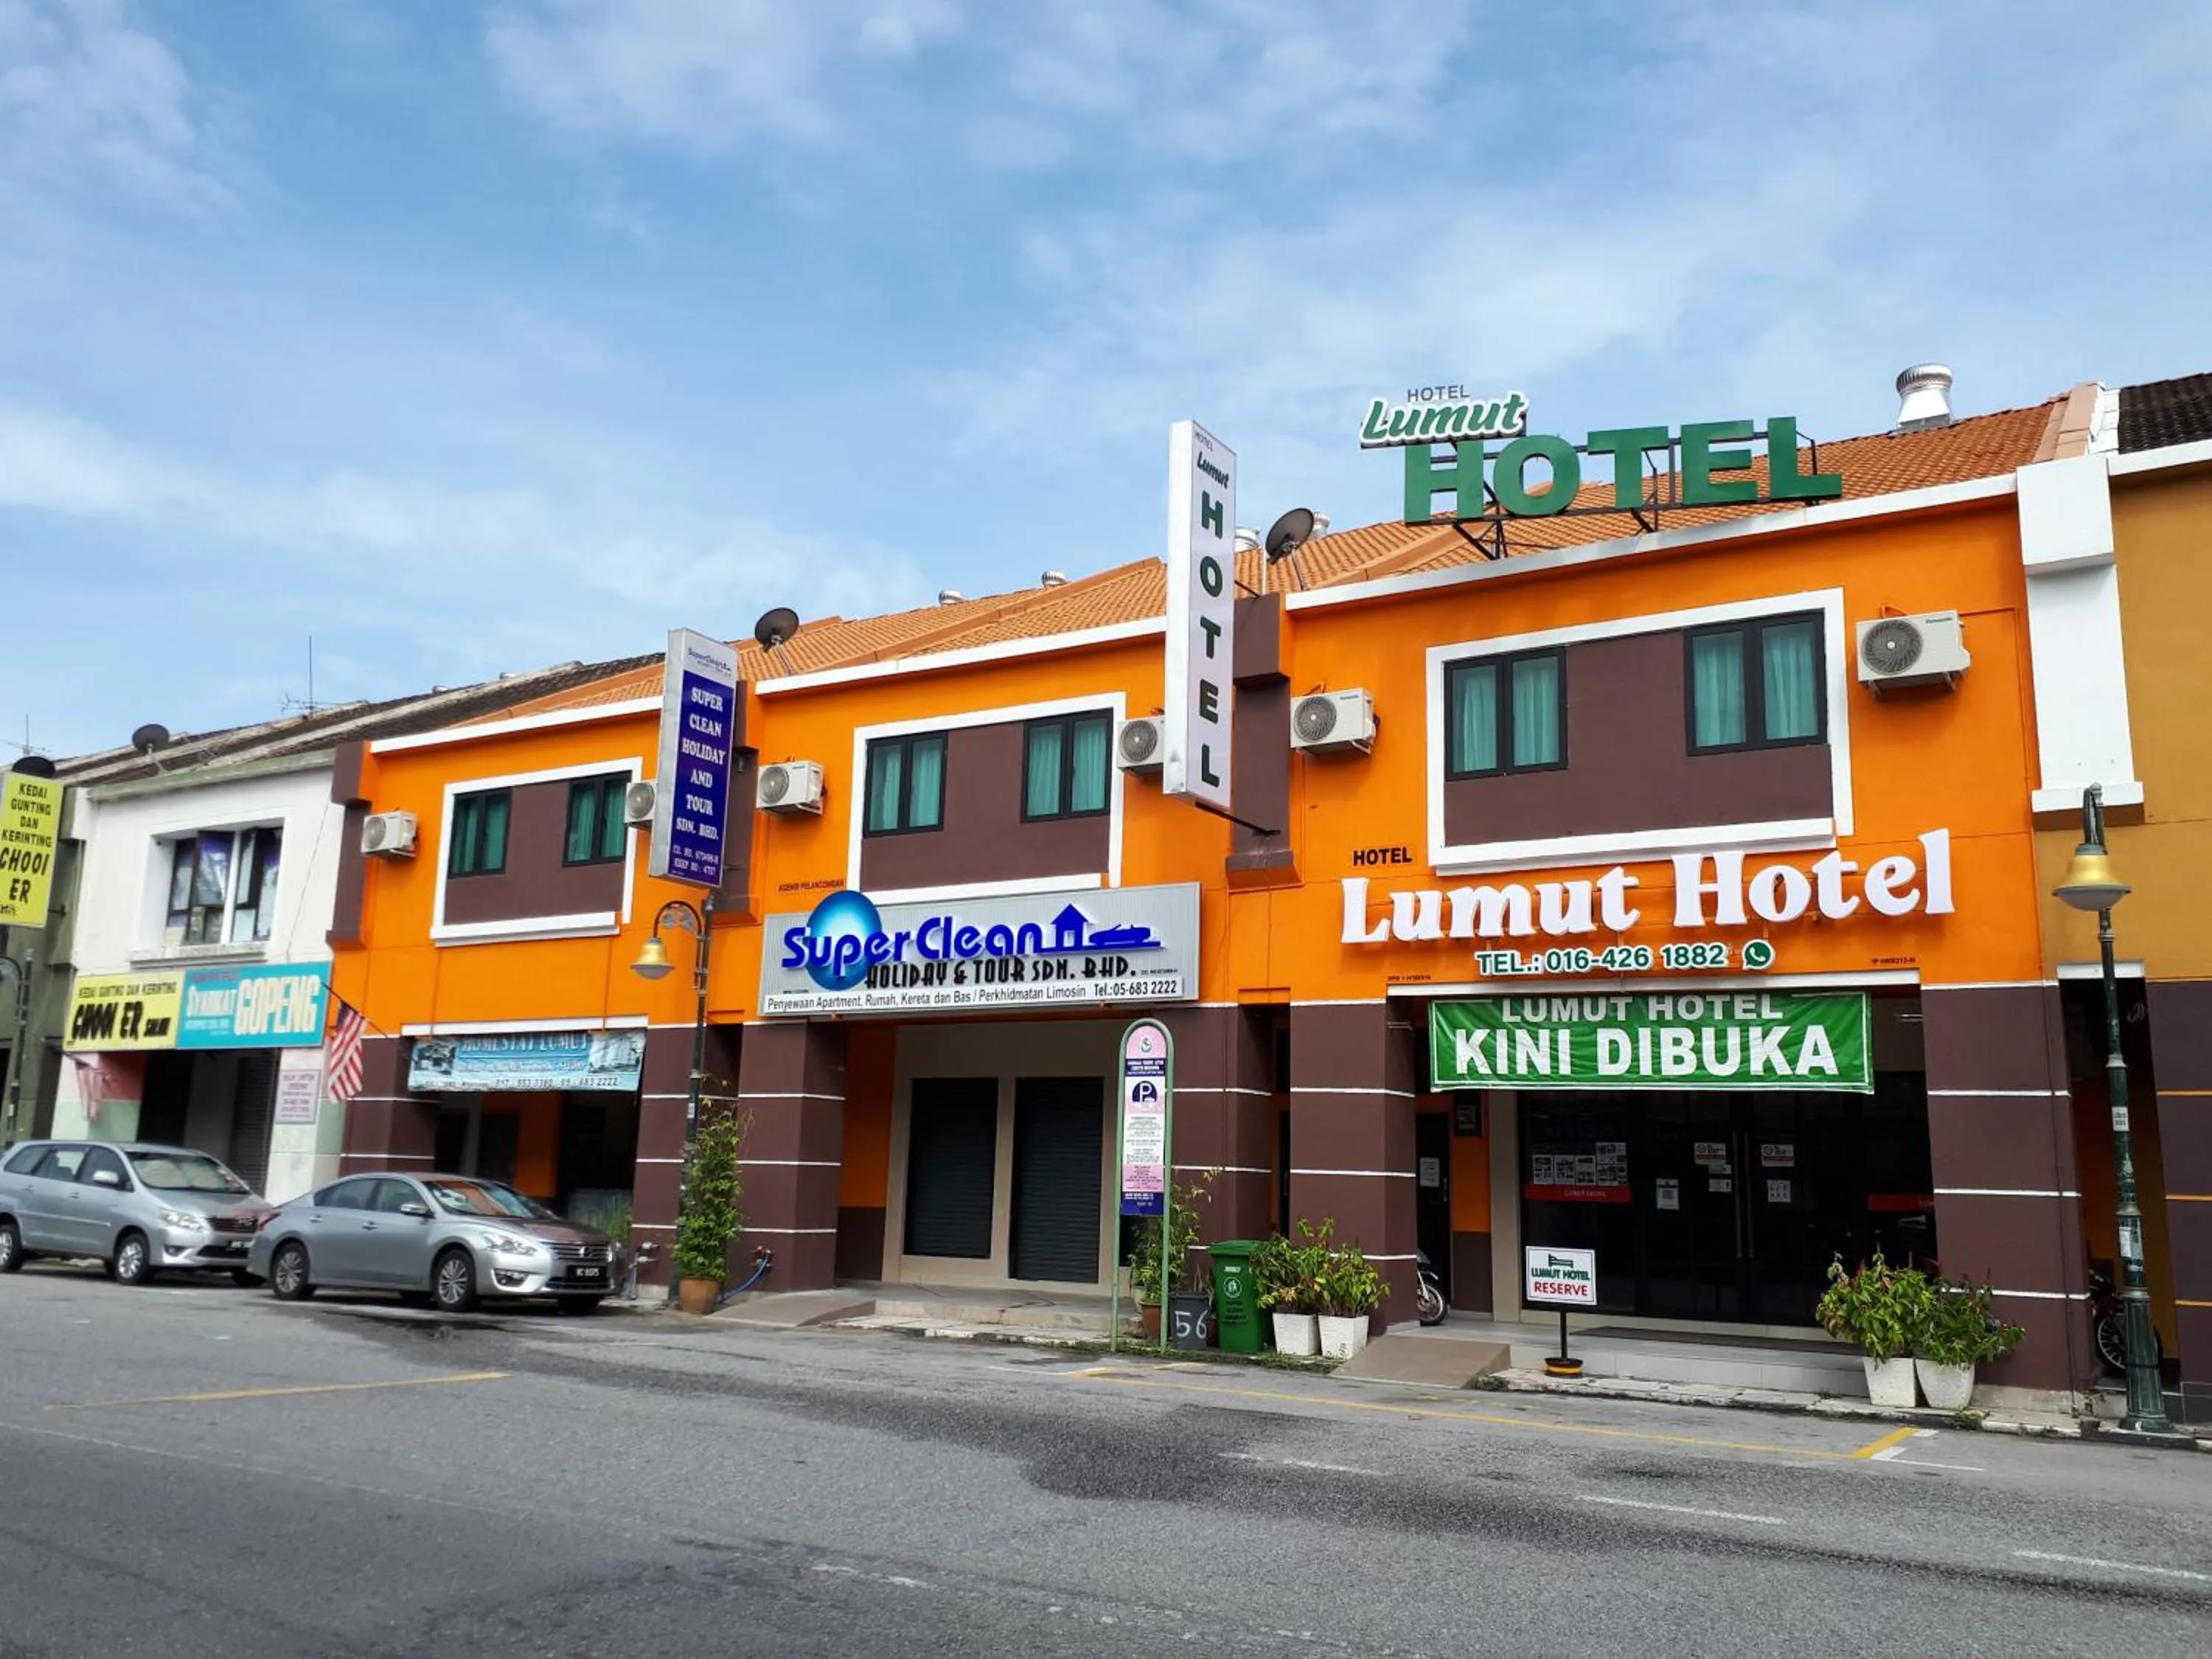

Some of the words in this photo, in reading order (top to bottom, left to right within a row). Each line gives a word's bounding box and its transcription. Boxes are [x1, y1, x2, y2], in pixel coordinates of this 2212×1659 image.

[1408, 384, 1470, 403] HOTEL
[1362, 392, 1525, 440] Lumut
[1197, 451, 1230, 490] Lumut
[1404, 416, 1843, 523] HOTEL
[1199, 490, 1223, 788] HOTEL
[691, 686, 723, 712] SUPER
[689, 713, 723, 737] CLEAN
[682, 738, 726, 765] HOLIDAY
[18, 782, 48, 799] KEDAI
[690, 768, 713, 788] AND
[11, 798, 52, 815] GUNTING
[685, 794, 713, 816] TOUR
[20, 815, 39, 830] DAN
[676, 817, 697, 834] SDN.
[1, 828, 52, 848] KERINTING
[0, 846, 49, 876] CHOOI
[1353, 847, 1413, 866] HOTEL
[9, 877, 31, 905] ER
[1341, 866, 1640, 943] Lumut
[1672, 828, 1955, 928] Hotel
[782, 917, 1043, 976] SuperClean
[1661, 945, 1725, 967] 1882
[865, 960, 947, 989] HOLIDAY
[953, 960, 967, 984] &
[973, 957, 1025, 985] TOUR
[1032, 958, 1075, 981] SDN.
[1082, 956, 1136, 978] BHD.
[234, 975, 320, 1036] GOPENG
[768, 998, 814, 1011] Penyewaan
[816, 996, 863, 1009] Apartment,
[866, 993, 898, 1006] Rumah,
[901, 993, 930, 1005] Kereta
[934, 992, 950, 1003] dan
[953, 990, 972, 1002] Bas
[979, 987, 1043, 1001] Perkhidmatan
[1046, 985, 1086, 998] Limosin
[1151, 980, 1178, 995] 2222
[1502, 996, 1632, 1023] LUMUT
[1648, 994, 1784, 1021] HOTEL
[120, 1001, 143, 1040] ER
[1455, 1029, 1573, 1075] KINI
[1597, 1026, 1839, 1076] DIBUKA
[1139, 1082, 1152, 1102] P
[1531, 1267, 1561, 1279] LUMUT
[1563, 1269, 1590, 1281] HOTEL
[1534, 1281, 1588, 1297] RESERVE
[1175, 1310, 1208, 1339] 56
